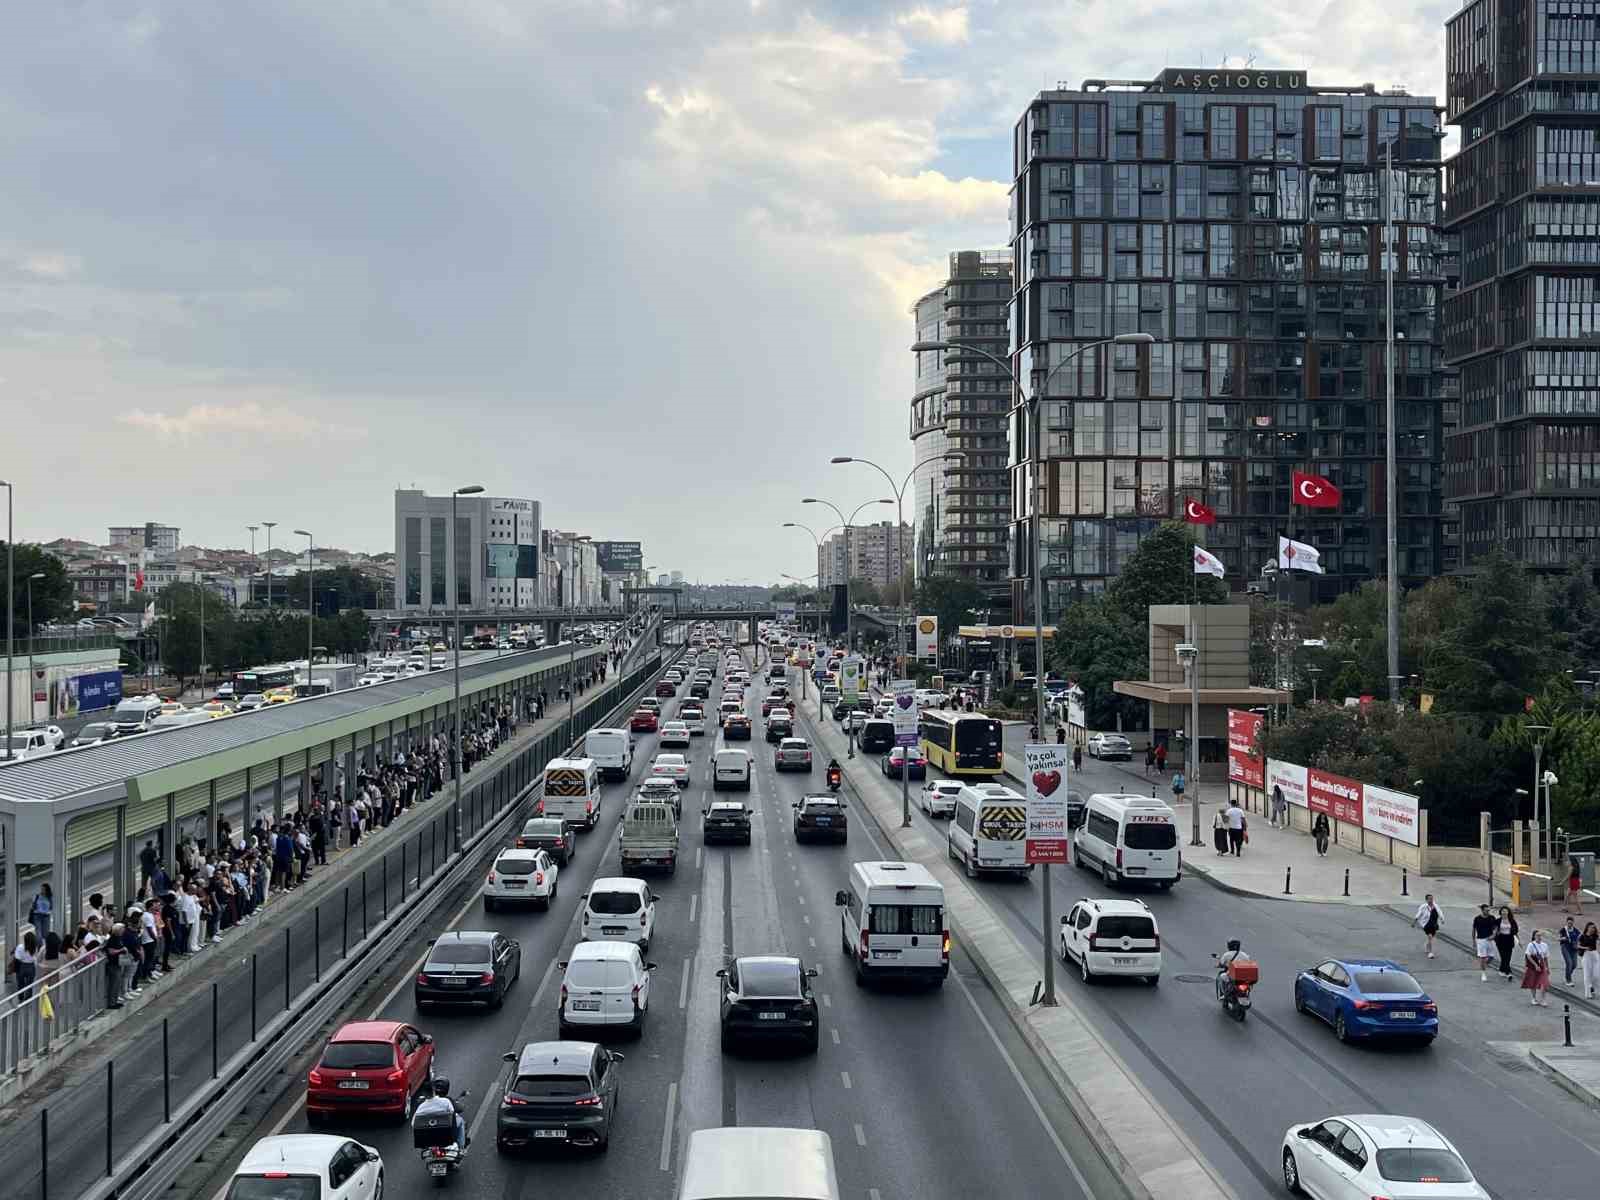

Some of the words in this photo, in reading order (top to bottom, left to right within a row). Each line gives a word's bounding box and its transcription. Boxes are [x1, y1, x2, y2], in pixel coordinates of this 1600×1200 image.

[1173, 72, 1300, 92] AŞÇIOĞLU
[1026, 752, 1038, 762] Ya
[1040, 750, 1056, 762] çok
[1028, 757, 1066, 771] yakınsa!
[1131, 815, 1169, 823] TUREX
